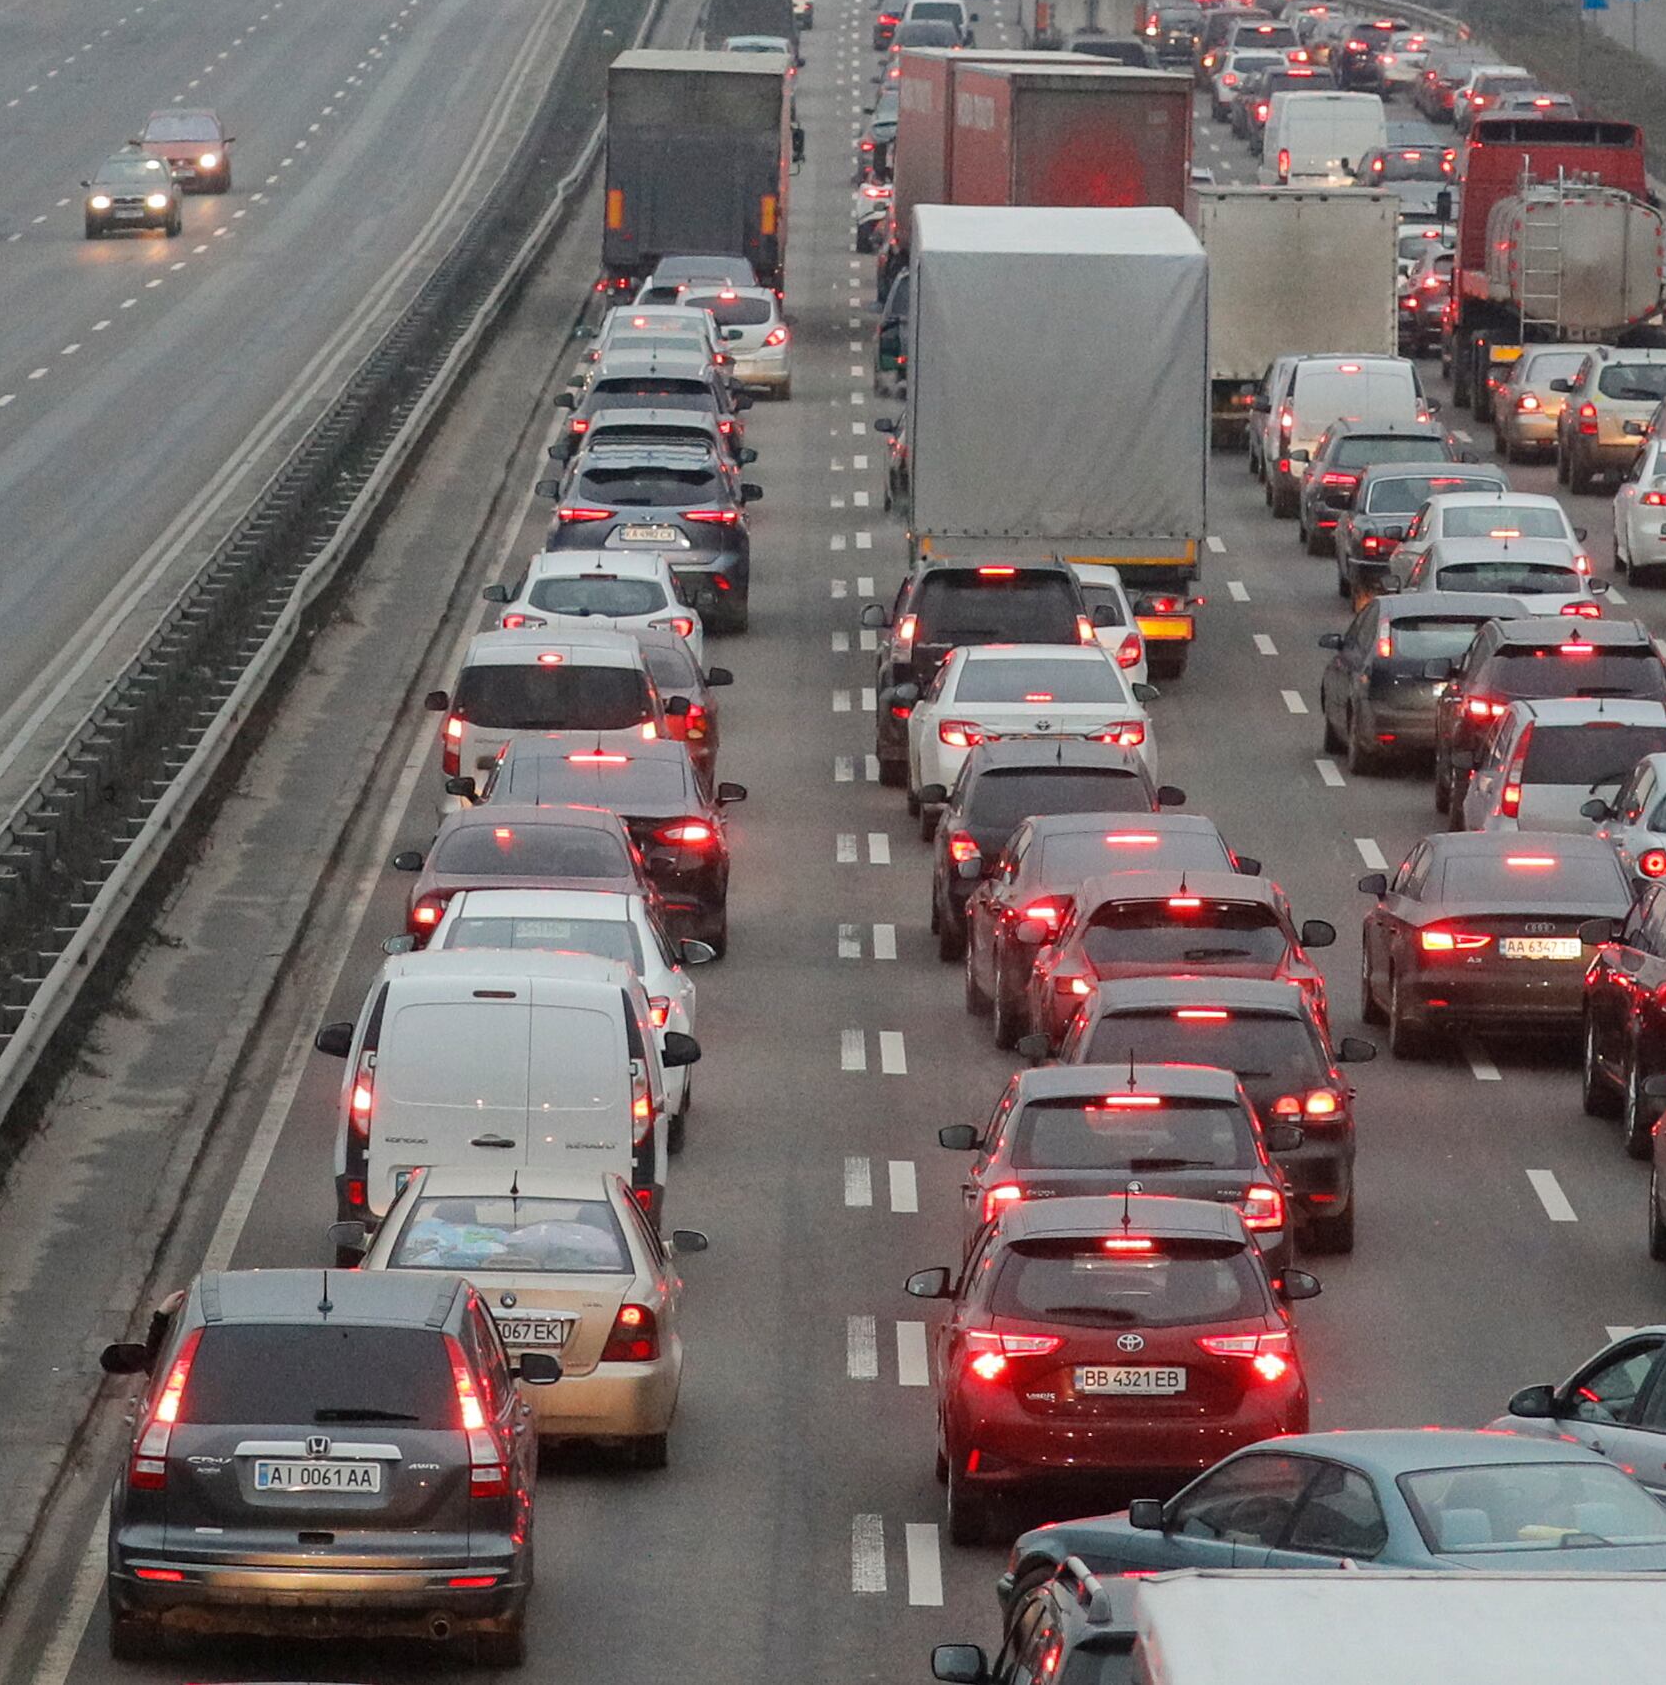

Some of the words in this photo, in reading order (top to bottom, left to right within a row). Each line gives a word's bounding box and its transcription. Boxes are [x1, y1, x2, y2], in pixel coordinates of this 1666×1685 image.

[1507, 942, 1525, 953] AA
[1528, 942, 1557, 954] 6347
[533, 1323, 559, 1342] EK
[1084, 1371, 1108, 1387] BB
[1113, 1371, 1151, 1387] 4321
[1155, 1371, 1180, 1388] EB
[187, 1456, 234, 1465] CR-V
[269, 1467, 290, 1486] AI
[299, 1467, 343, 1487] 0061
[346, 1468, 373, 1488] AA
